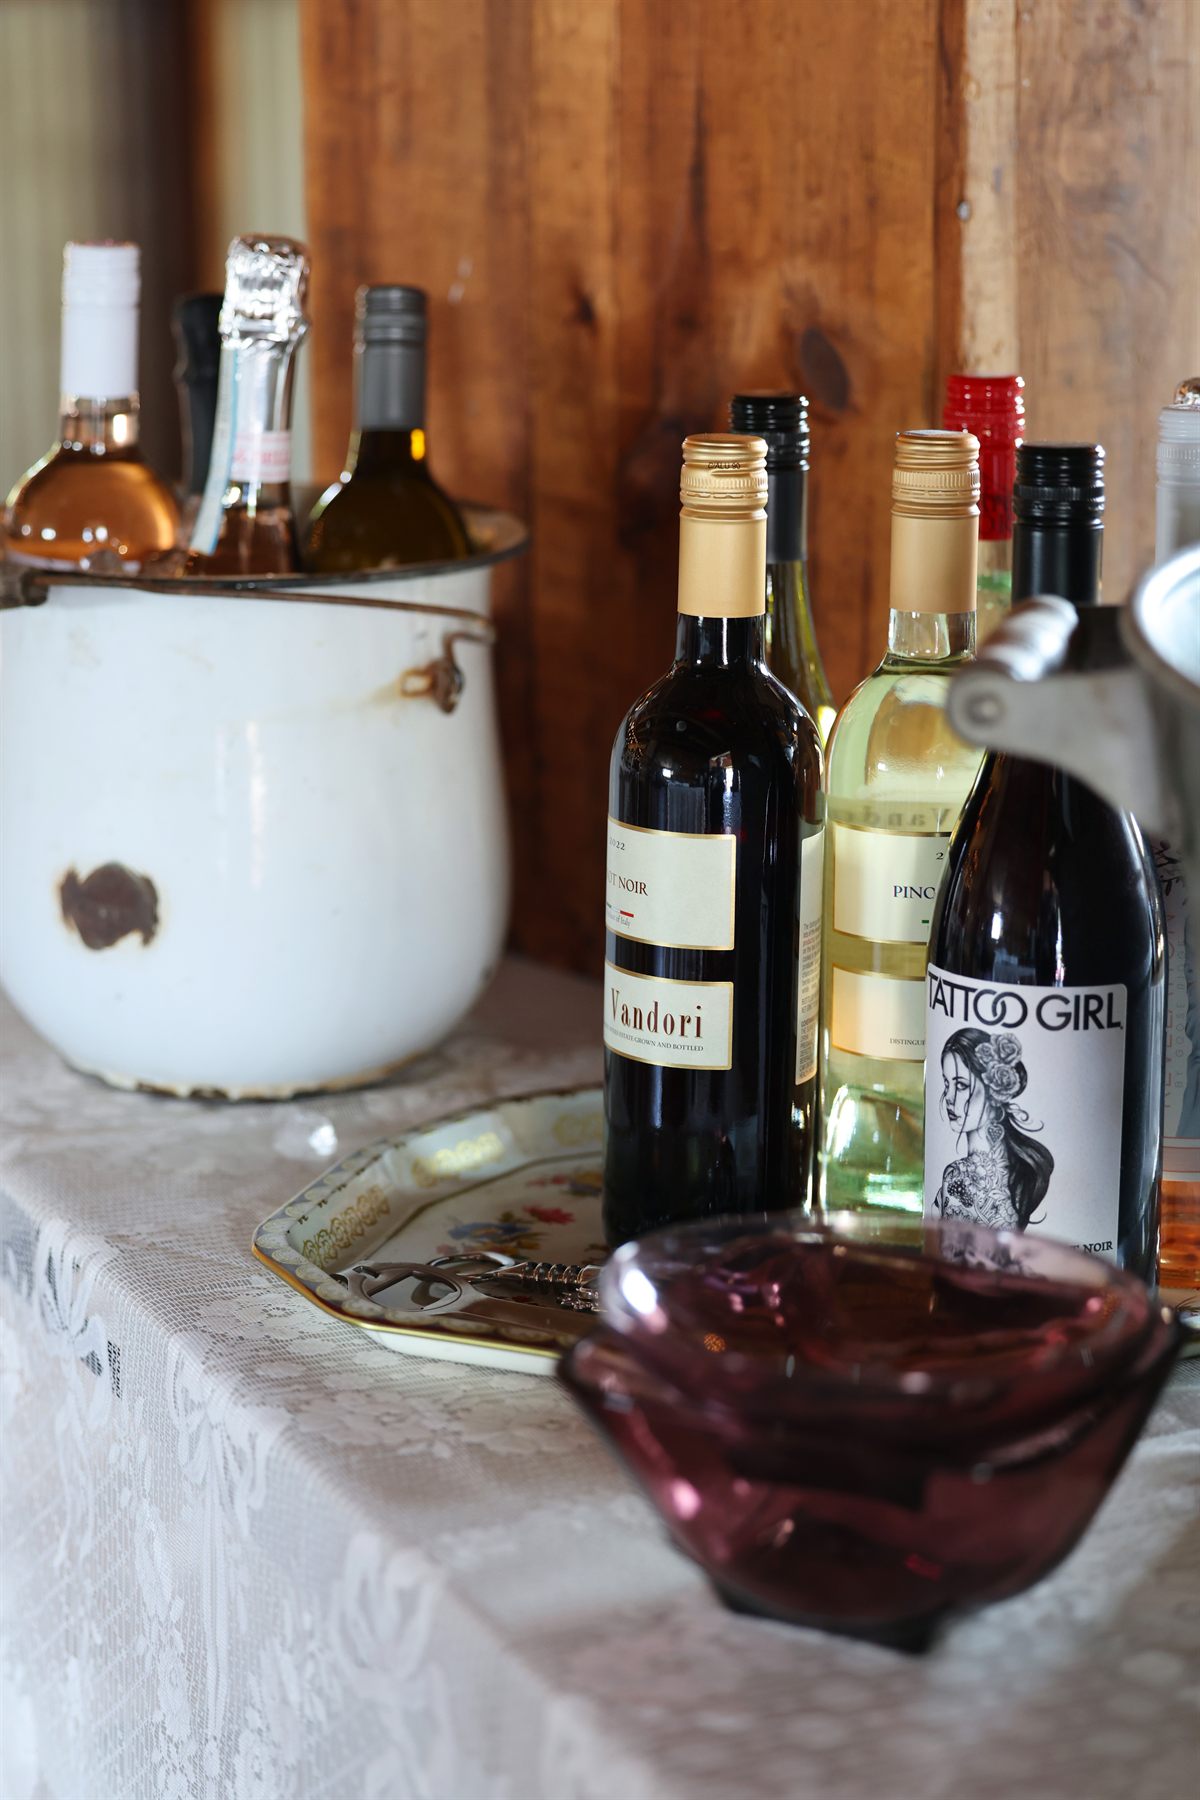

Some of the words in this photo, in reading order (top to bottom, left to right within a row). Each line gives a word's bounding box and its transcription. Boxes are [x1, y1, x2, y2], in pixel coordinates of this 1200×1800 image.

[619, 875, 648, 896] NOIR
[611, 988, 703, 1038] Vandori
[928, 970, 1028, 1028] TATTOO
[1036, 992, 1121, 1031] GIRL
[634, 1036, 656, 1047] GROWN
[1175, 1002, 1184, 1057] GOOSE
[1083, 1240, 1113, 1254] NOIR
